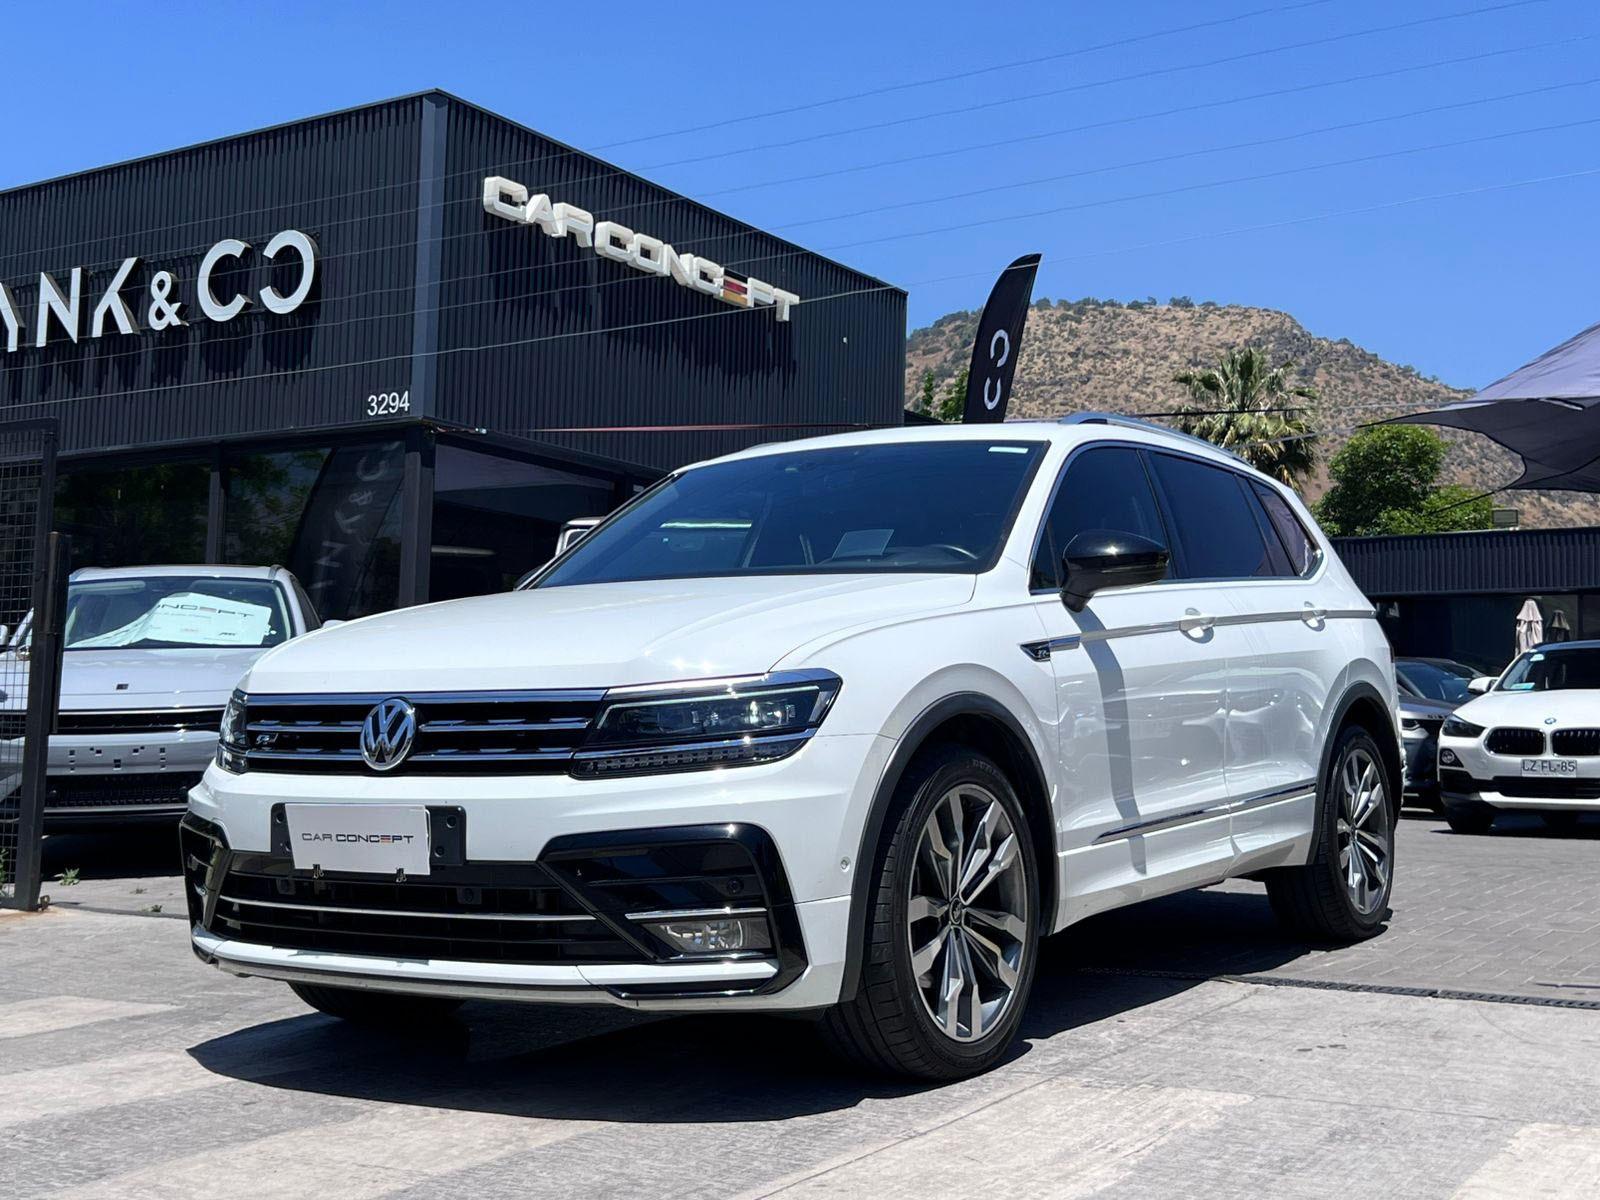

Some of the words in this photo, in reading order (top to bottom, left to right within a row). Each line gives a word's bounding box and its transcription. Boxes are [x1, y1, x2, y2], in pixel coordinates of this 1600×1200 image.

[484, 176, 594, 247] CAR
[367, 390, 410, 416] 3294
[301, 832, 333, 842] CAR
[335, 833, 415, 844] CONCEPT
